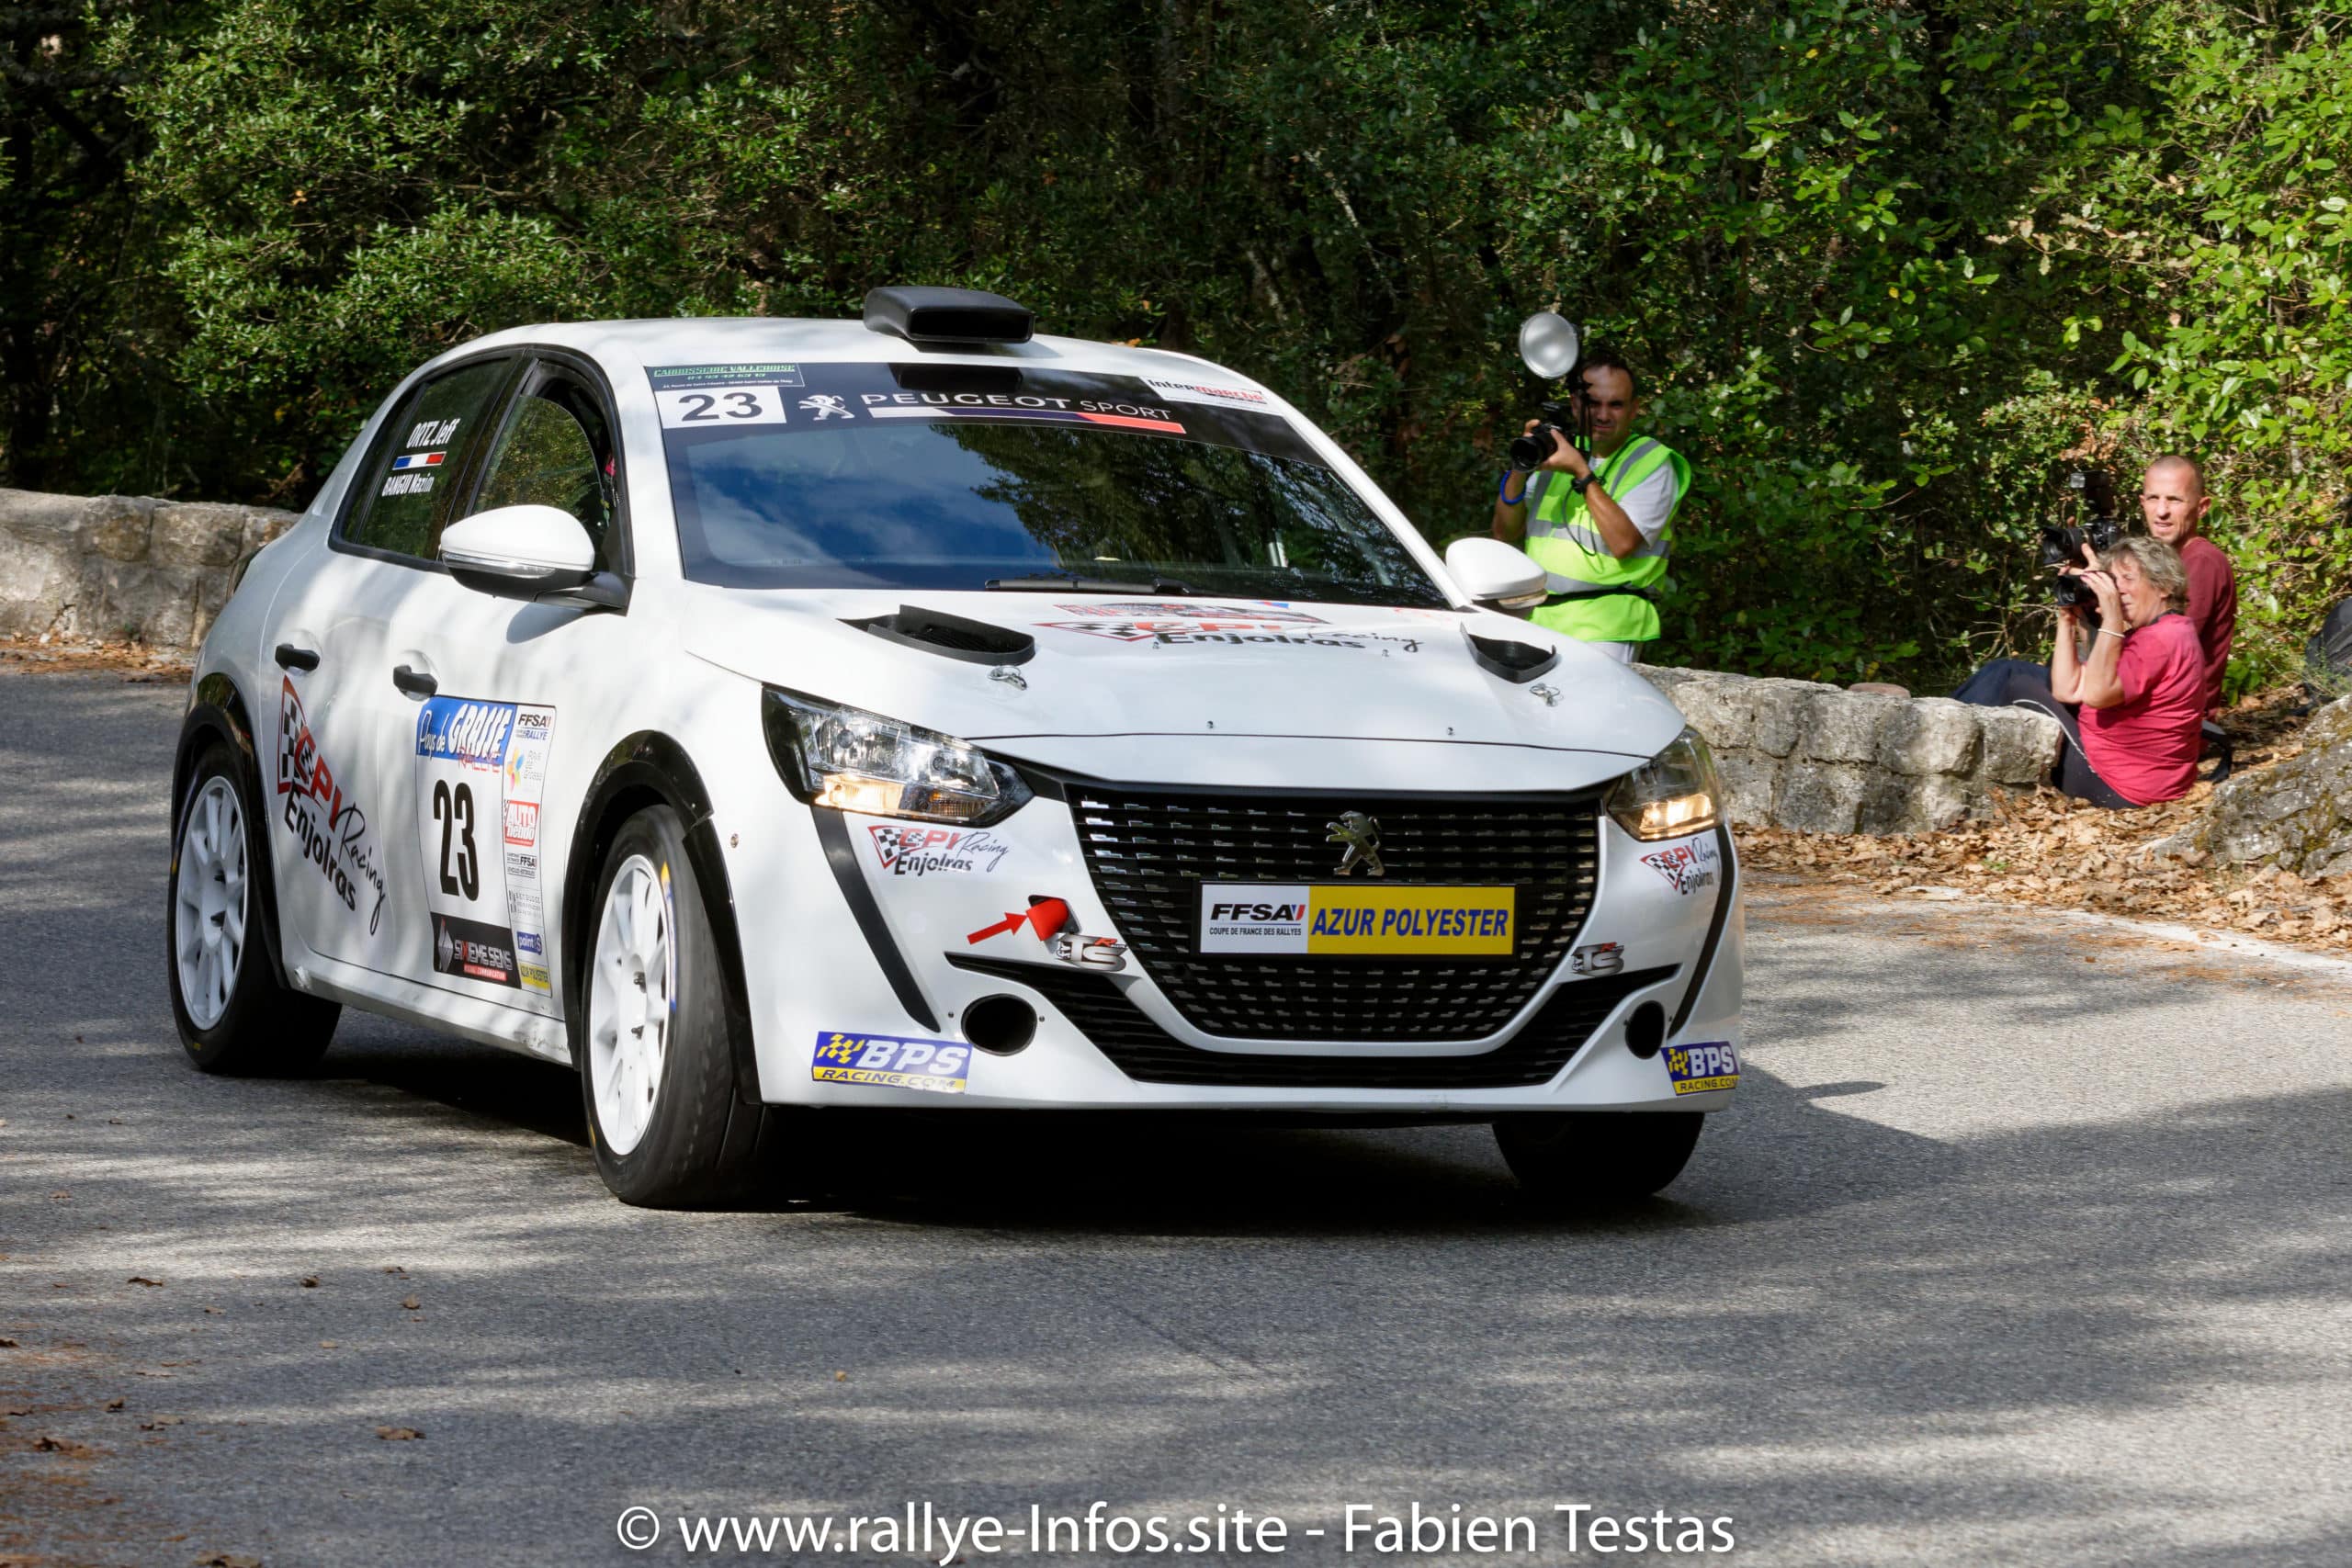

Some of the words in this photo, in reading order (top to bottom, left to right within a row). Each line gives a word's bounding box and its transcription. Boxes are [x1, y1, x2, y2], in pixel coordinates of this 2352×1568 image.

[678, 392, 763, 422] 23
[860, 393, 1070, 409] PEUGEOT
[1080, 400, 1170, 421] SPORT
[429, 418, 460, 446] Jeff
[1154, 632, 1366, 649] Enjolras
[419, 710, 435, 761] Pays
[435, 713, 450, 753] de
[448, 704, 513, 759] GRASSE
[518, 714, 548, 728] FFSA
[525, 730, 548, 740] RALLYE
[508, 805, 536, 828] AUTO
[285, 779, 356, 911] Enjolras
[434, 779, 479, 901] 23
[953, 831, 1012, 873] Racing
[335, 801, 385, 936] Racing
[520, 856, 535, 868] FFSA
[895, 852, 973, 876] Enjolras
[1679, 868, 1714, 895] Enjolras
[1210, 904, 1297, 920] FFSA
[1311, 908, 1375, 936] AZUR
[1381, 908, 1509, 937] POLYESTER
[518, 935, 534, 951] point
[1209, 927, 1229, 935] COUPE
[1230, 927, 1239, 935] DE
[1240, 928, 1263, 936] FRANCE
[1264, 928, 1275, 936] DES
[1275, 928, 1302, 936] RALLYES
[855, 1039, 969, 1075] BPS
[1688, 1046, 1735, 1077] BPS
